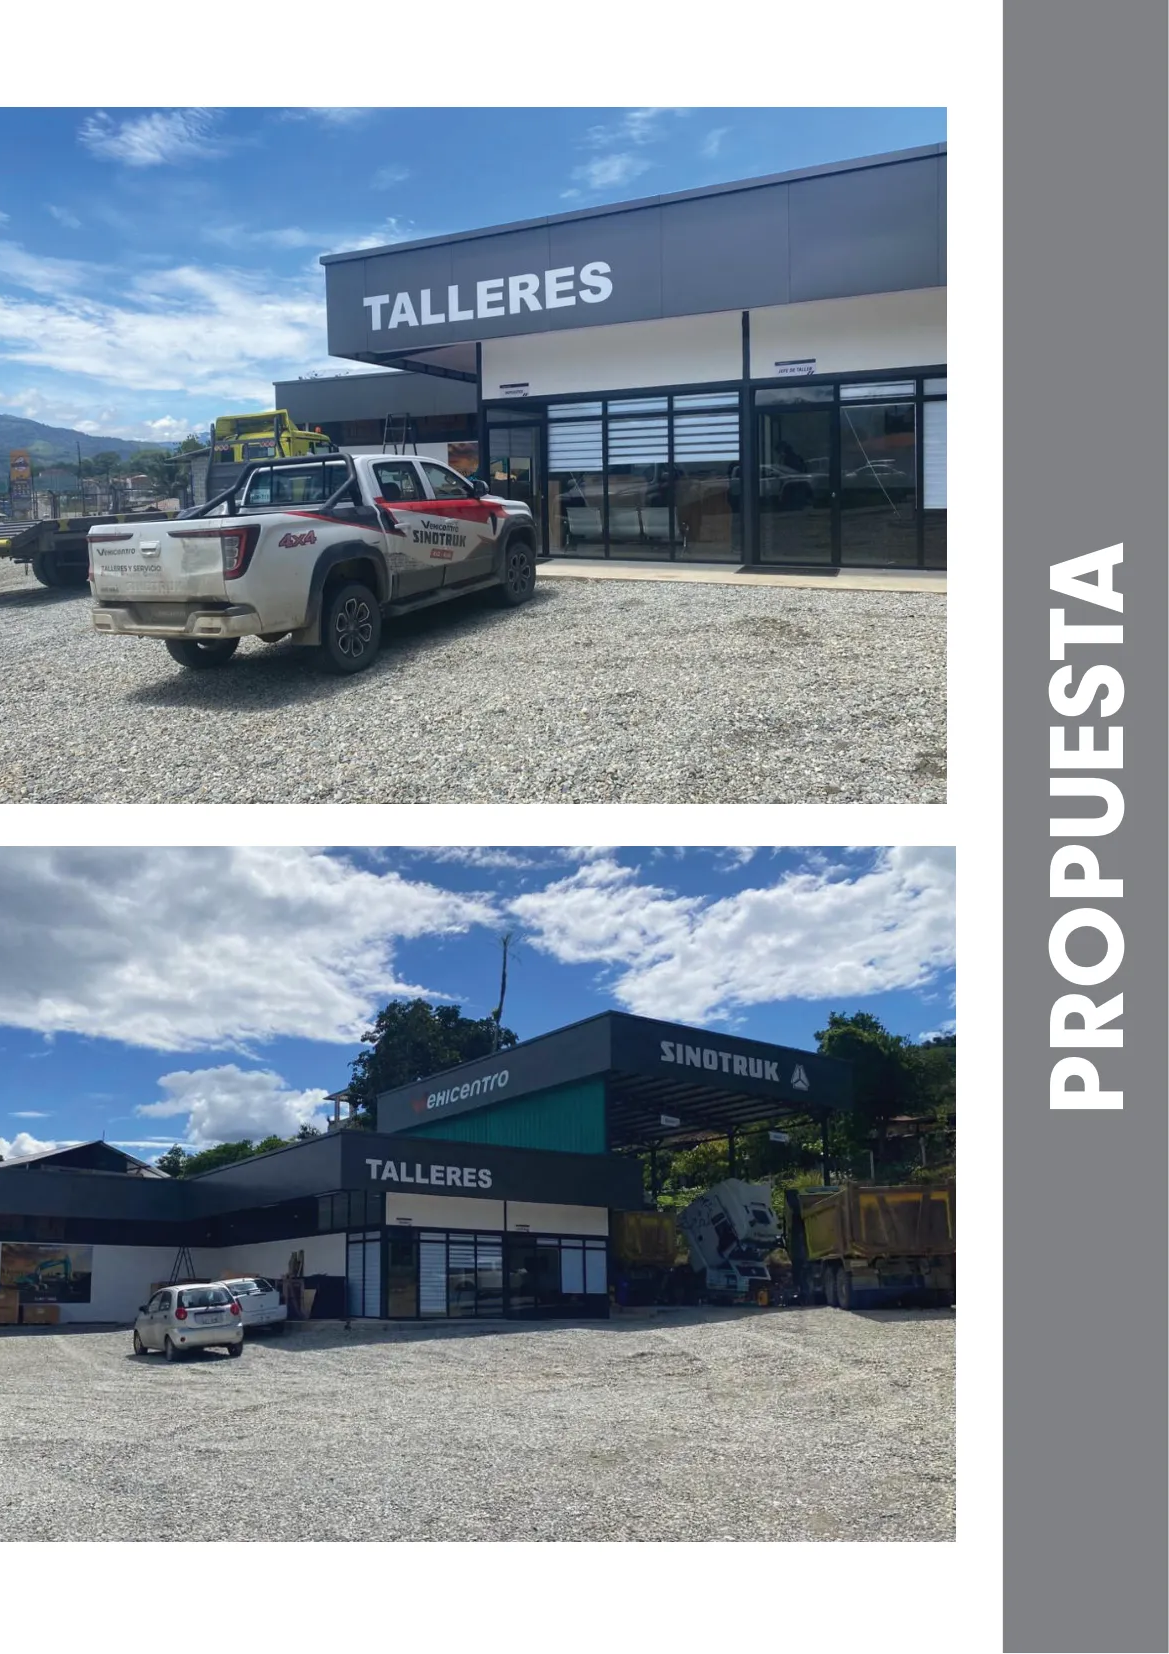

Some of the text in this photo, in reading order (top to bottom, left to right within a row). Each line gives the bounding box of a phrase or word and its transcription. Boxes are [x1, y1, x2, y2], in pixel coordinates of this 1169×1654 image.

[363, 261, 613, 331] TALLERES
[278, 530, 318, 549] 4x4
[412, 529, 467, 547] SINOTRUK
[100, 564, 128, 572] TALLERES
[133, 564, 162, 572] SERVICIO
[660, 1040, 779, 1082] SINOTRUK
[365, 1158, 493, 1189] TALLERES
